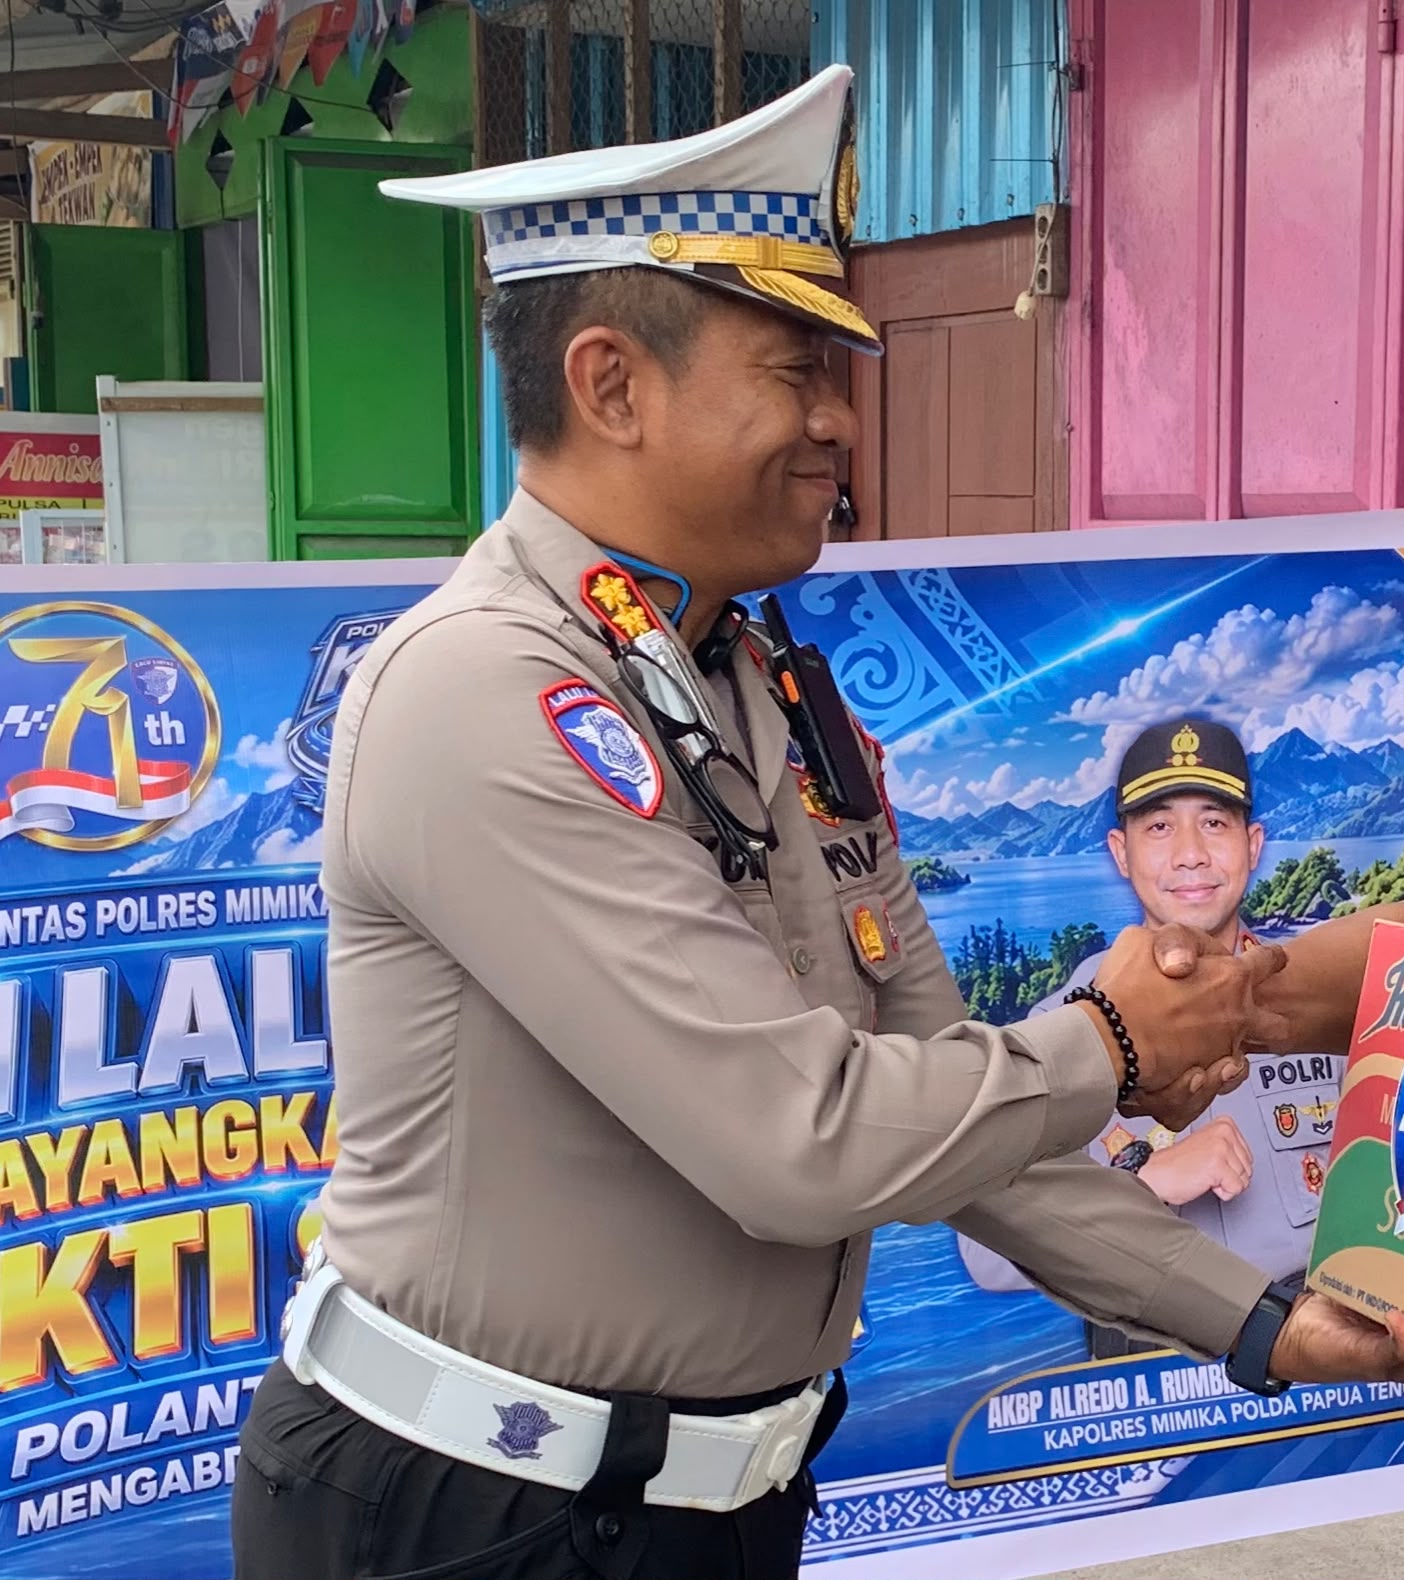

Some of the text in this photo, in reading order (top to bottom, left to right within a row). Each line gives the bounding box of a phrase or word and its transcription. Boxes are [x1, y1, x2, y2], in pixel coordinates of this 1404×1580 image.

[0, 901, 86, 946] NTAS
[97, 889, 217, 935] POLRES
[58, 948, 330, 1111] LAL
[1259, 1056, 1332, 1089] POLRI
[988, 1362, 1244, 1429] AKBP ALREDO A. RUMBI
[1044, 1416, 1147, 1451] KAPOLRES
[1152, 1405, 1227, 1435] MIMIKA
[1231, 1395, 1297, 1424] POLDA
[1302, 1386, 1363, 1412] PAPUA
